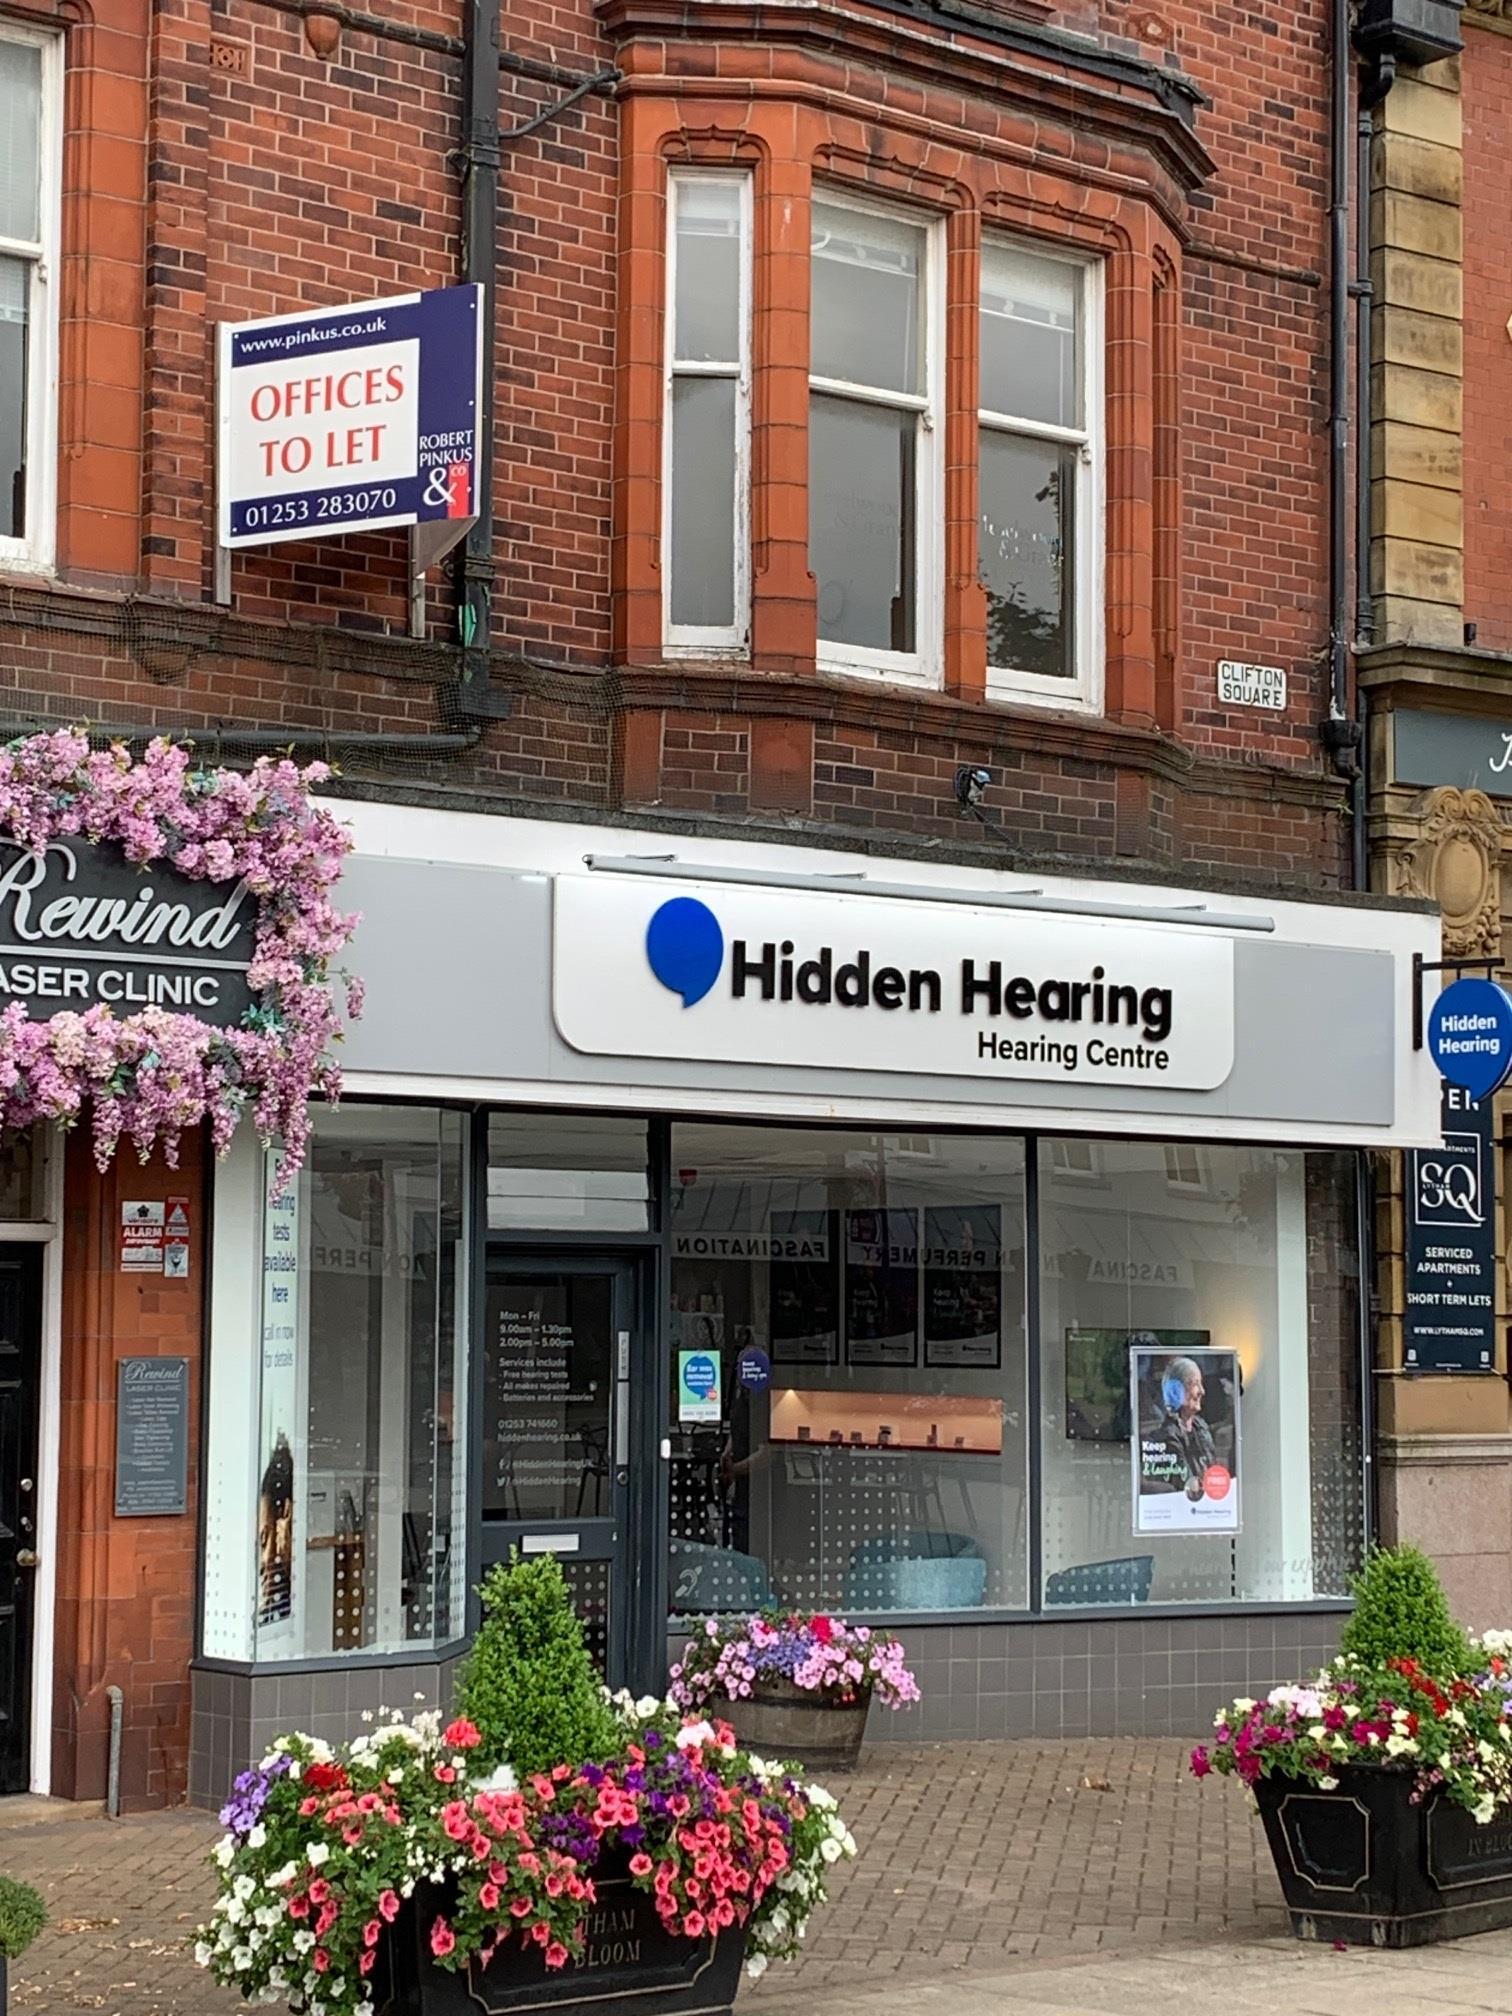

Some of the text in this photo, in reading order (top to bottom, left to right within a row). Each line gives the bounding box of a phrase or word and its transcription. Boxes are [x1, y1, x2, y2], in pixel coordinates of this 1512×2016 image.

[241, 317, 387, 353] www.pinkus.co.uk
[250, 365, 405, 422] OFFICES
[419, 430, 473, 450] ROBERT
[259, 424, 387, 478] TO LET
[419, 447, 473, 467] PINKUS
[422, 467, 458, 506] &
[246, 488, 396, 527] 01253 283070
[1221, 663, 1283, 688] CLIFTON
[1223, 683, 1282, 707] SQUARE
[0, 837, 249, 949] Rewind
[97, 970, 220, 1006] CLINIC
[731, 939, 1173, 1040] Hidden Hearing
[1441, 1014, 1497, 1032] Hidden
[978, 1031, 1169, 1071] Hearing Centre
[1439, 1035, 1500, 1055] Hearing
[1420, 1162, 1487, 1222] SQ
[122, 1227, 163, 1238] ALARM
[272, 1222, 290, 1242] tests
[264, 1251, 296, 1273] available
[1425, 1246, 1474, 1259] SERVICED
[1416, 1262, 1482, 1275] APARTMENTS
[271, 1282, 288, 1303] here
[1407, 1293, 1492, 1307] SHORT TERM LETS
[499, 1311, 519, 1320] Mon
[528, 1311, 540, 1320] Fri
[499, 1325, 533, 1335] 9.00am
[541, 1325, 573, 1336] 1.30pm
[499, 1338, 533, 1348] 2.00pm
[541, 1338, 575, 1348] 5.00pm
[124, 1361, 184, 1380] Rewind
[499, 1357, 567, 1367] Services include
[503, 1370, 568, 1380] Free hearing tests
[503, 1382, 513, 1390] All
[498, 1419, 526, 1429] 01253
[1141, 1441, 1167, 1452] Keep
[1142, 1453, 1178, 1464] hearing
